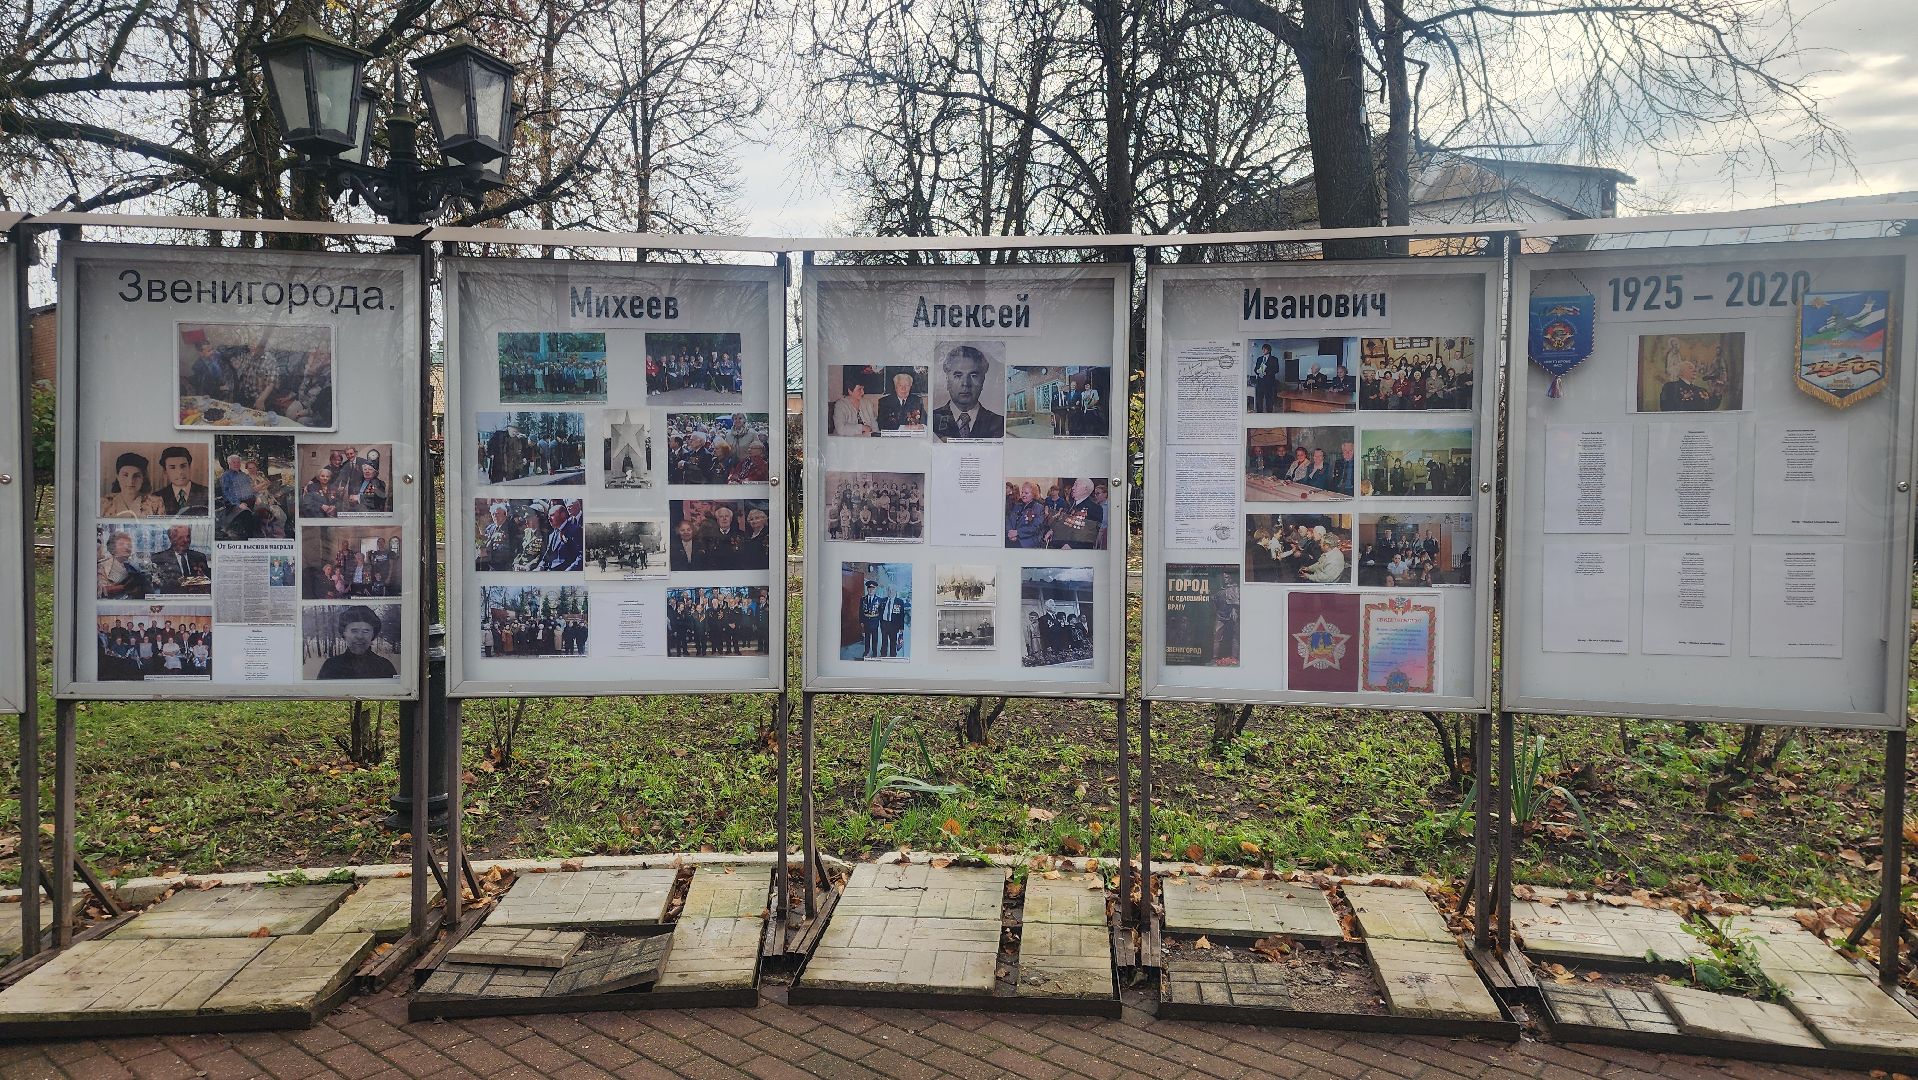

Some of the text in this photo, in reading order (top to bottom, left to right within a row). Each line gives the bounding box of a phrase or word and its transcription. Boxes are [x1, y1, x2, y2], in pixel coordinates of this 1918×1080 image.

[118, 269, 395, 315] Звенигорода.
[570, 287, 679, 319] Михеев
[1243, 288, 1386, 320] Иванович
[1608, 274, 1683, 312] 1925
[1725, 270, 1811, 307] 2020
[912, 293, 1030, 328] Алексей
[1168, 578, 1210, 594] ГОРОД
